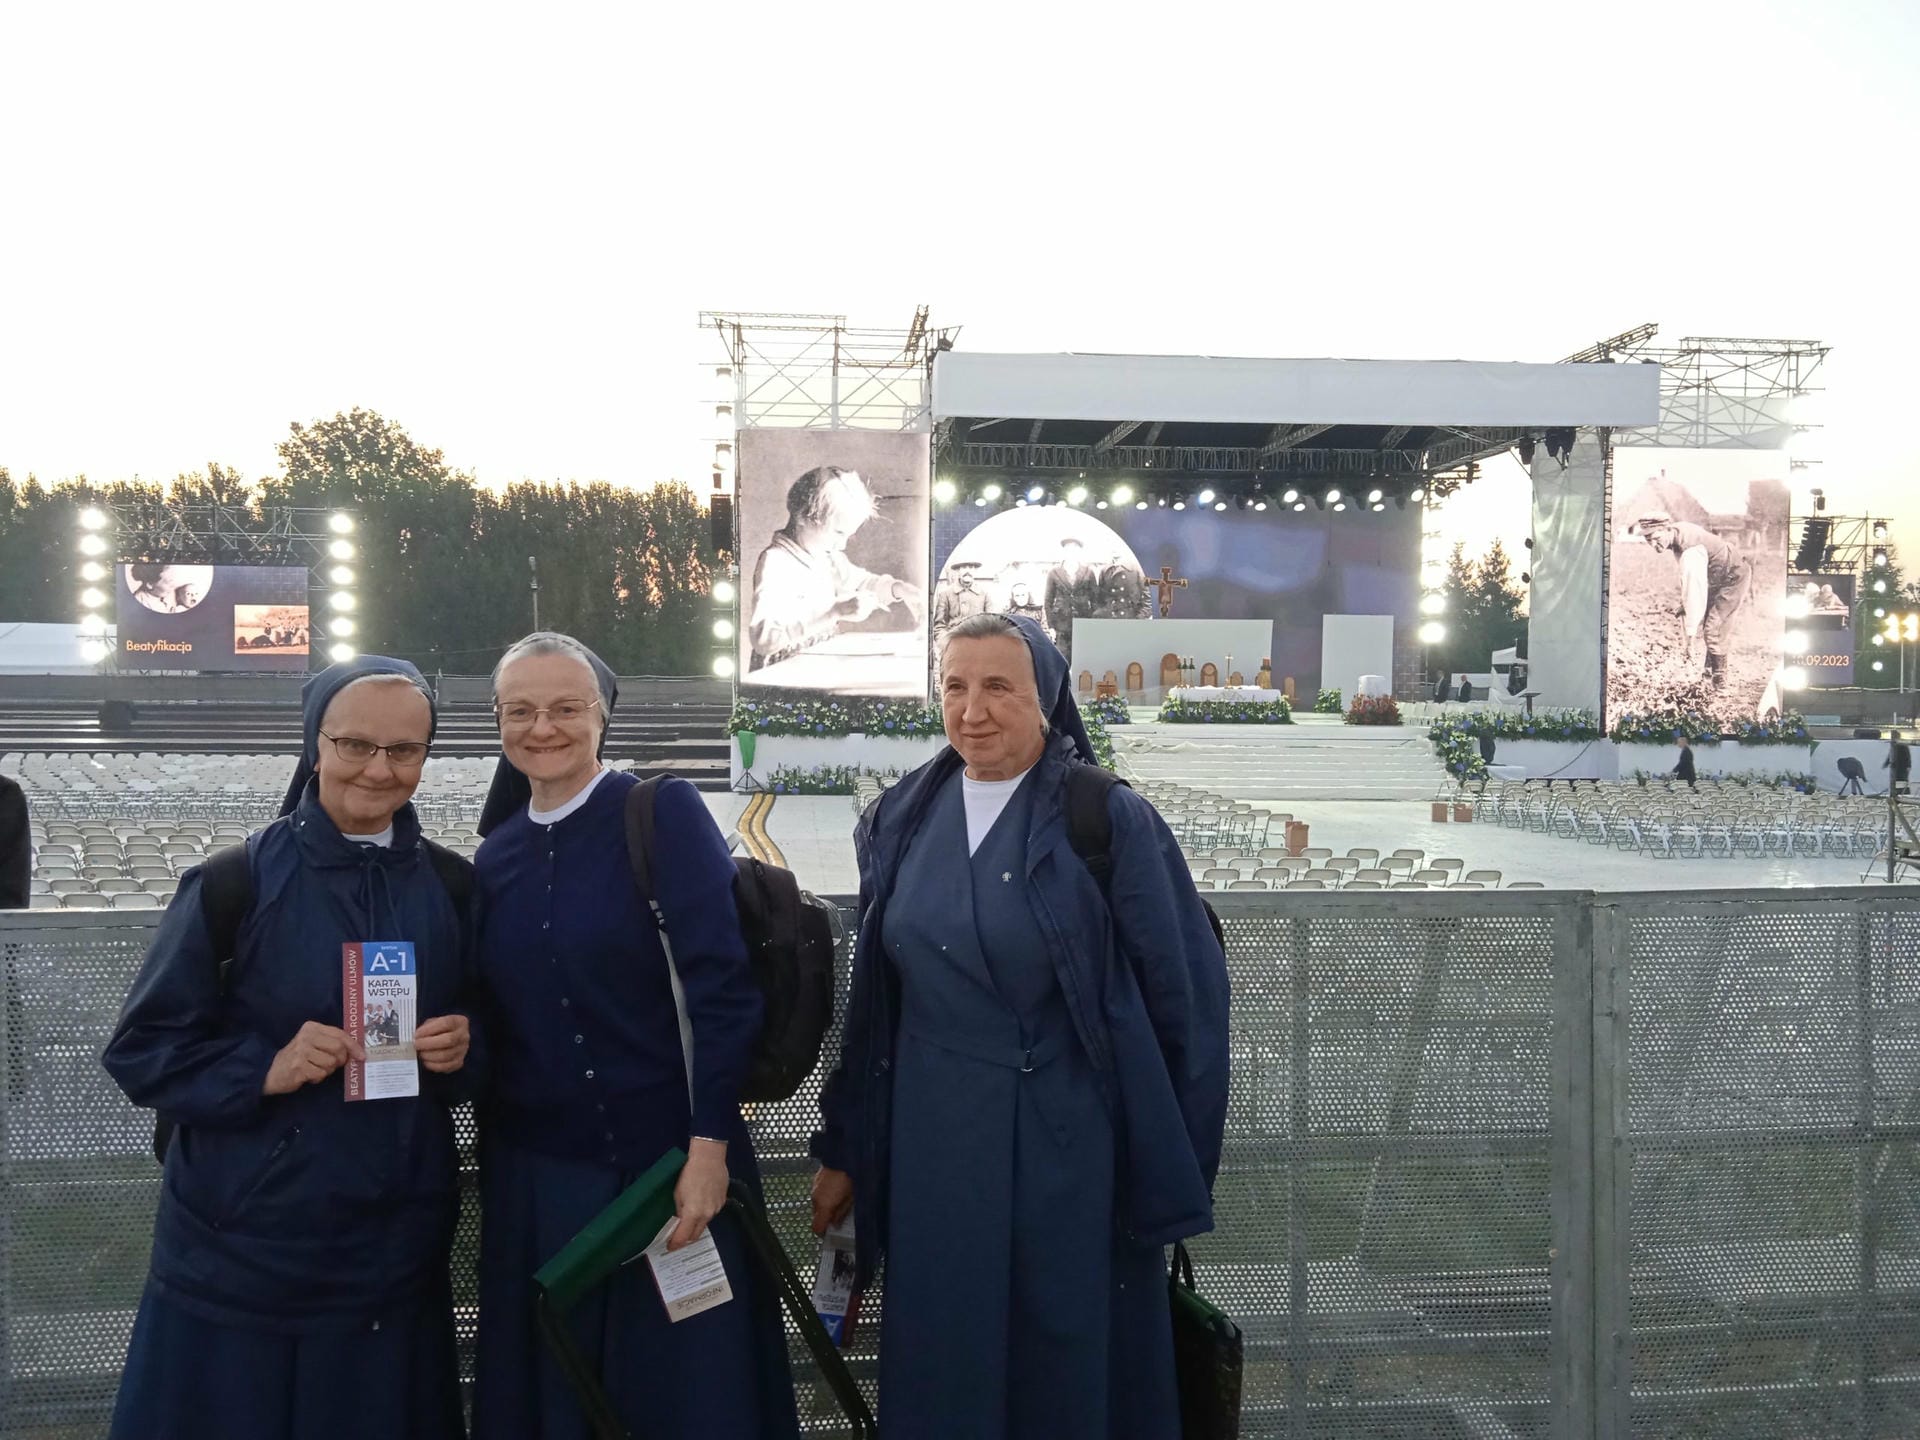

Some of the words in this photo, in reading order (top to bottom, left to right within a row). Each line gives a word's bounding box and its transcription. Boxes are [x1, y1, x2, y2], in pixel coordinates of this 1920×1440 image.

[126, 640, 192, 654] Beatyfikacja
[348, 949, 357, 985] ULMÓW
[370, 951, 406, 971] A-1
[368, 980, 401, 988] KARTA
[368, 987, 410, 998] WSTĘPU
[349, 987, 358, 1027] RODZINY
[350, 1029, 358, 1096] BEATYFJA
